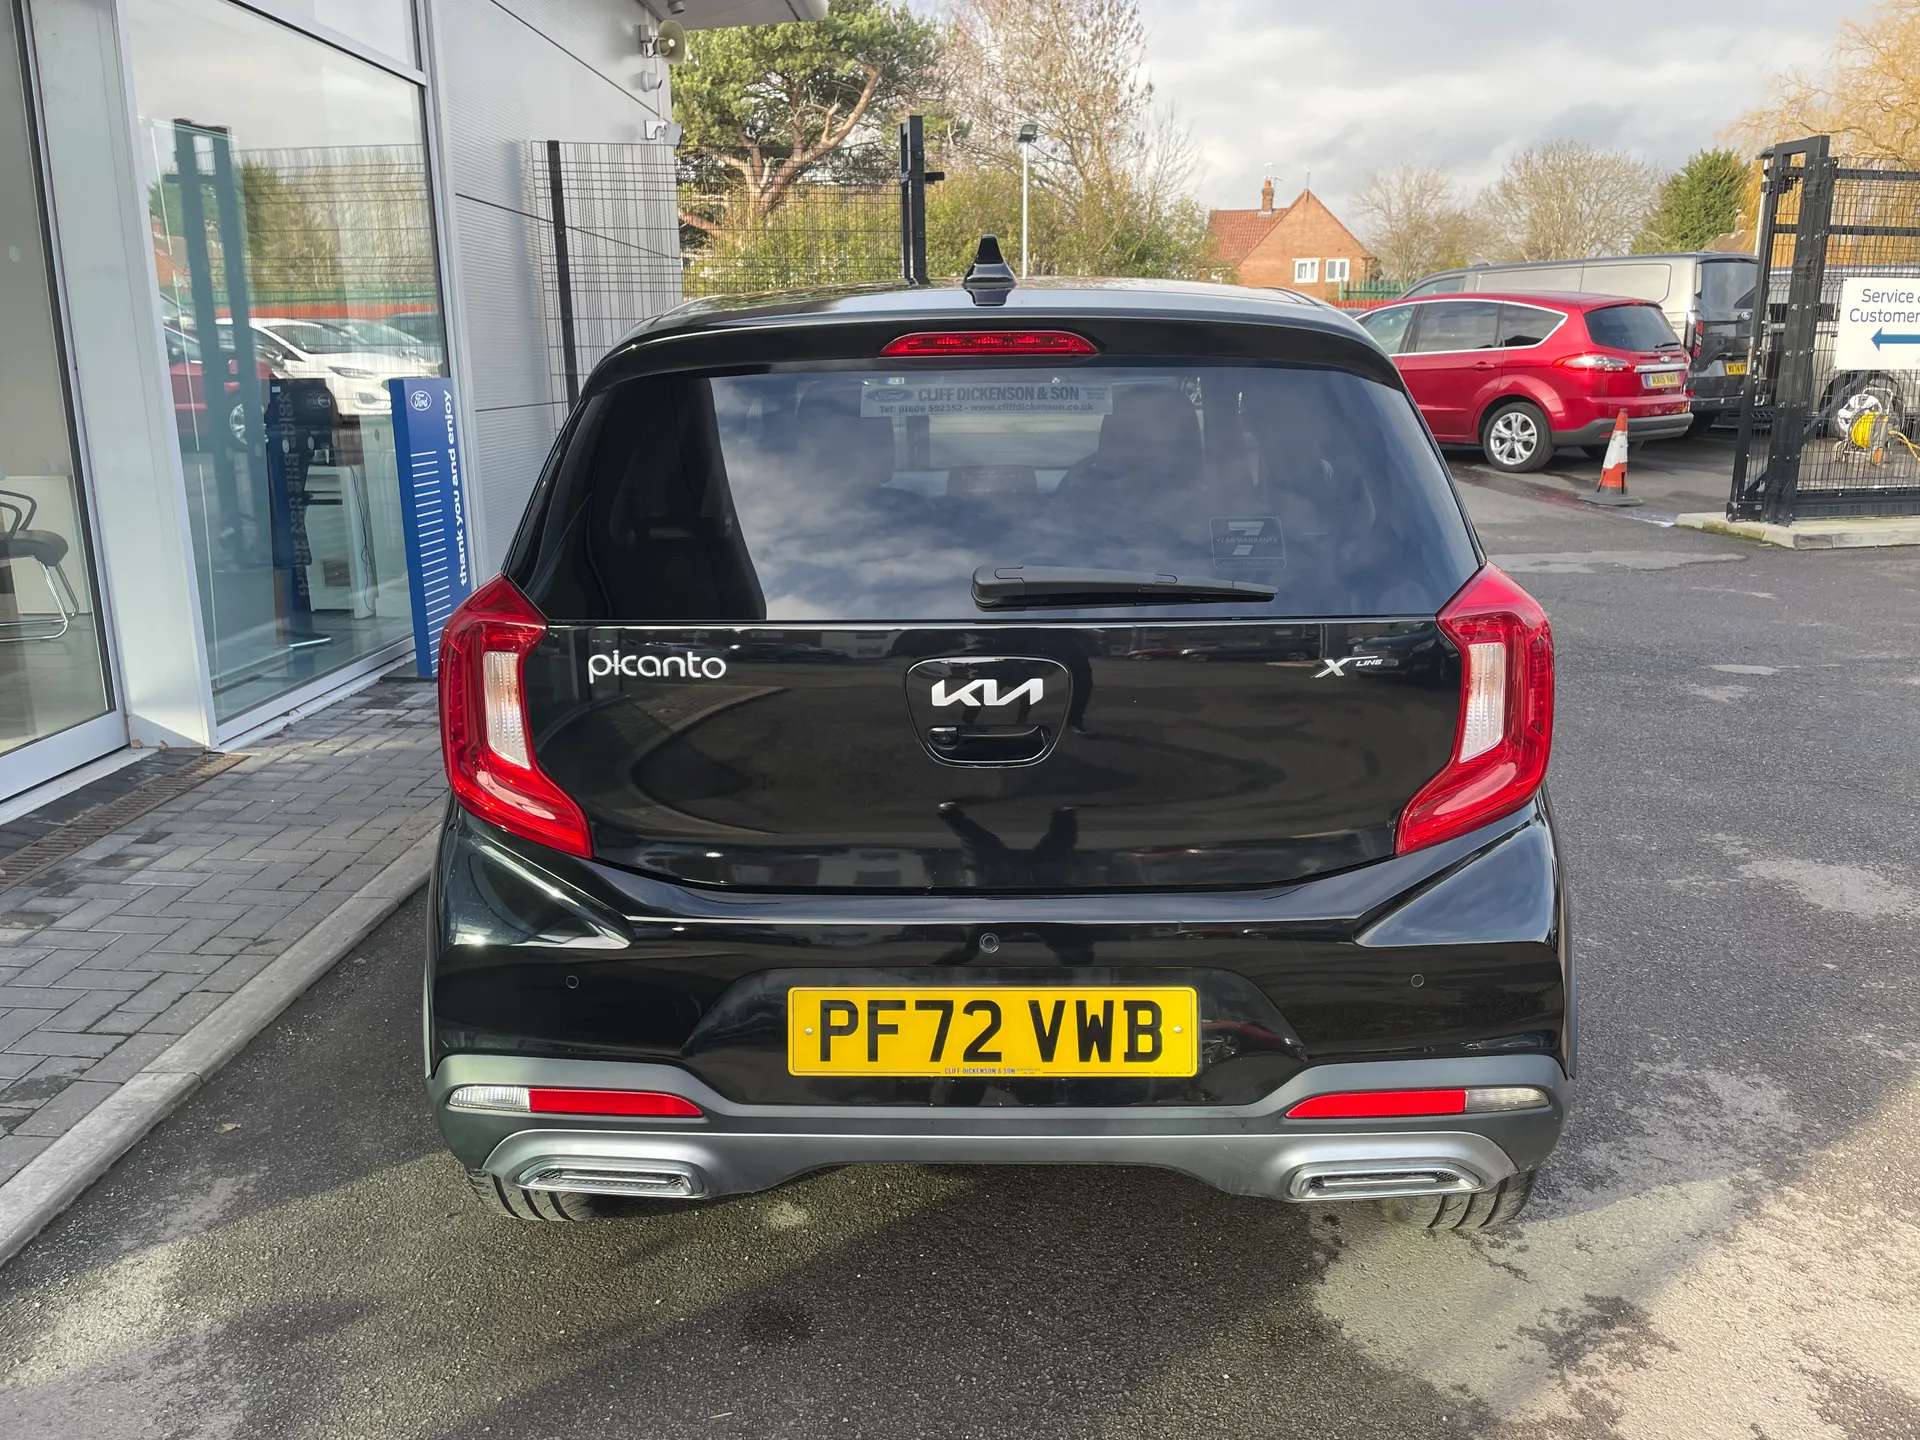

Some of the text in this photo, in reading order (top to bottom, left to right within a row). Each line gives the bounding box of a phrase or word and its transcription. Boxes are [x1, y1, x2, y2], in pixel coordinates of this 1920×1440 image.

[1861, 289, 1914, 303] Service
[1849, 308, 1920, 323] Customer
[918, 388, 954, 401] CLIFF
[957, 386, 1034, 400] DICKENSON
[1036, 386, 1048, 400] &
[1051, 385, 1079, 400] SON
[443, 390, 467, 586] thank you and enjoy
[588, 650, 727, 684] picanto
[1314, 656, 1383, 678] X LINE
[931, 678, 1044, 706] KIA
[819, 1000, 1163, 1062] PF72 VWB
[963, 1067, 996, 1075] DICKENSON
